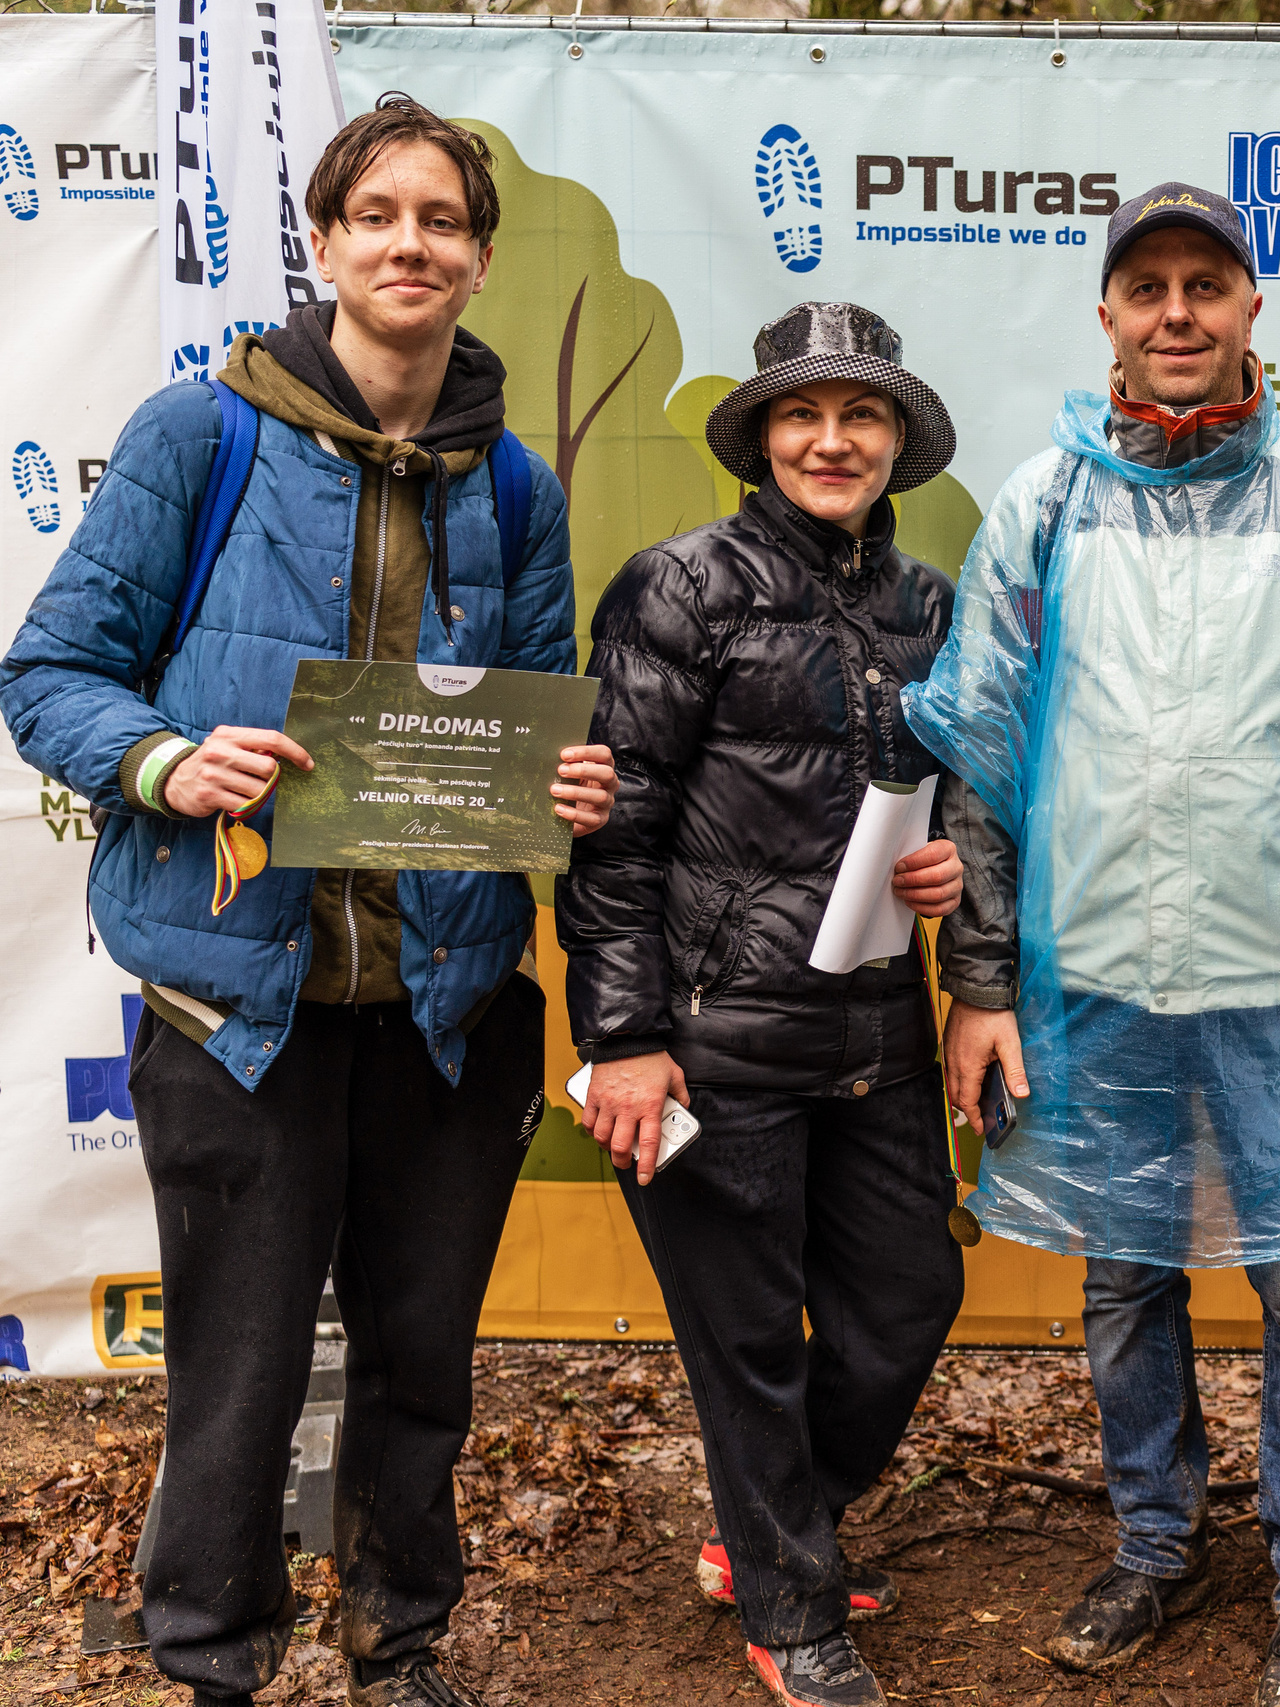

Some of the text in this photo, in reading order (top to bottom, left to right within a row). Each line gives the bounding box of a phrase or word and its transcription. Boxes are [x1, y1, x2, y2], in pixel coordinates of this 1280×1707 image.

[60, 187, 155, 202] Impossible
[856, 154, 1120, 216] PTuras
[1135, 193, 1211, 223] John Deere
[856, 221, 1087, 245] Impossible we do
[378, 712, 502, 738] DIPLOMAS
[425, 743, 453, 751] komanda
[488, 745, 501, 753] kad
[413, 794, 465, 806] KELIAIS
[67, 1133, 105, 1151] The
